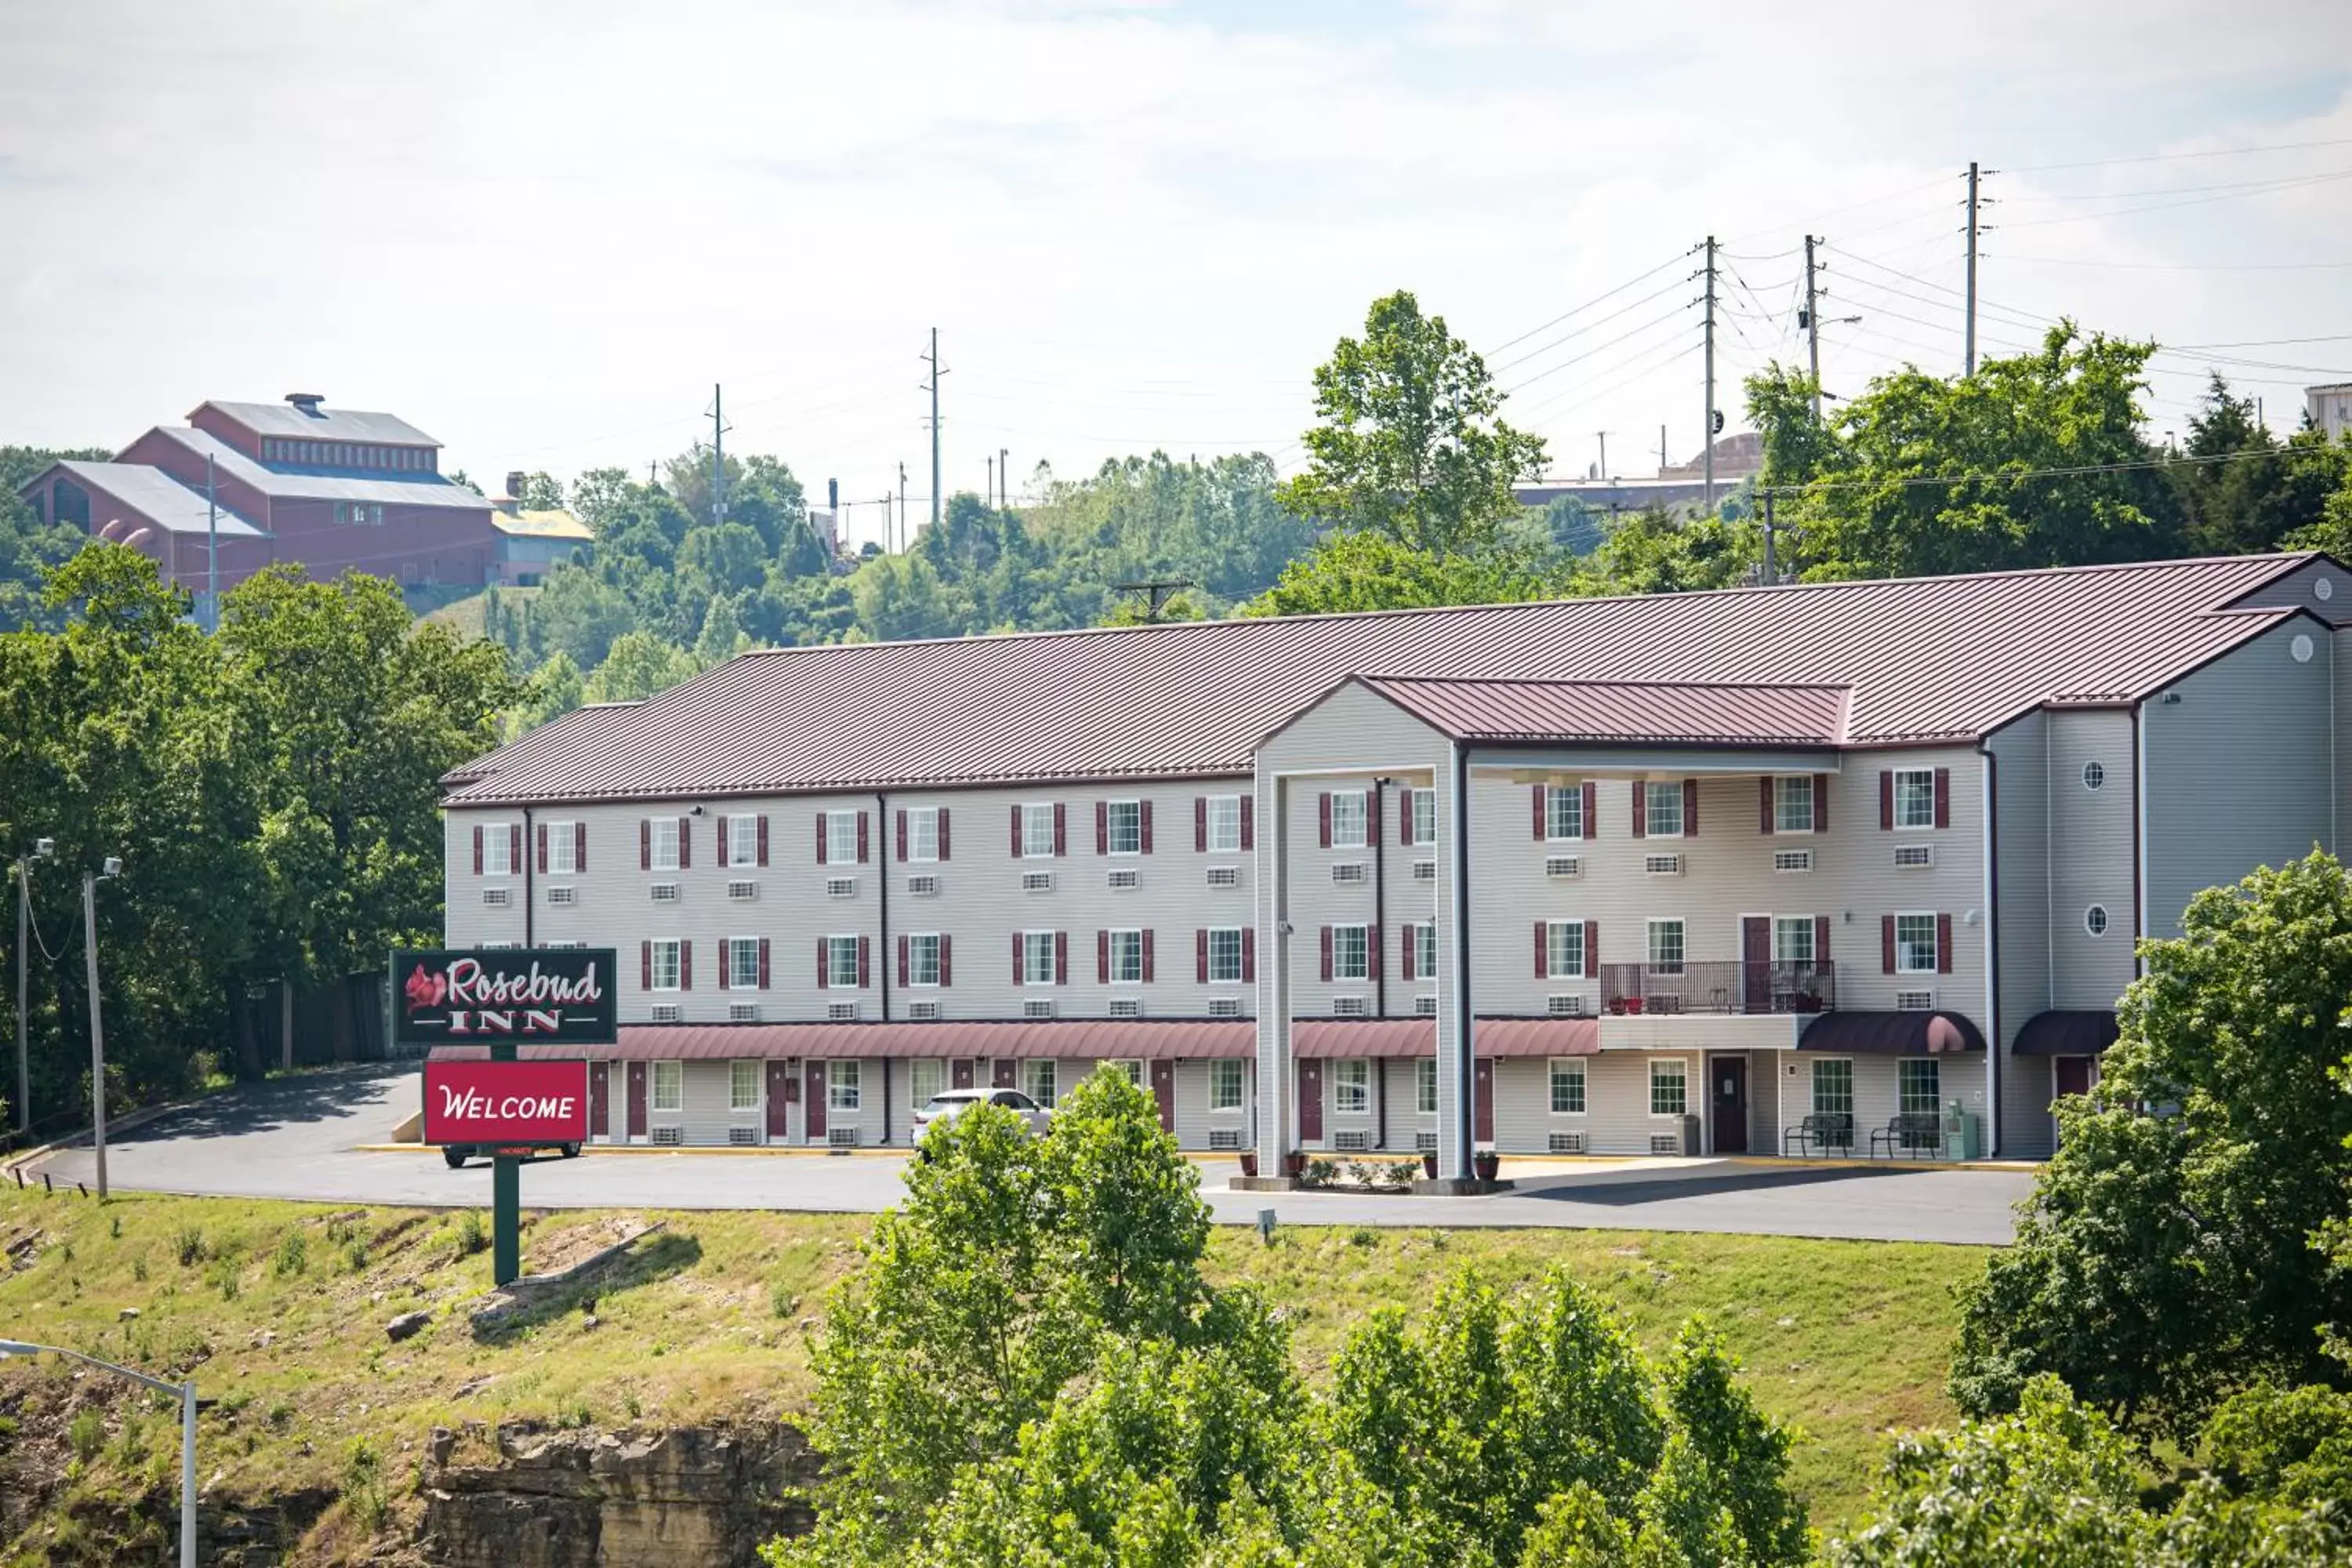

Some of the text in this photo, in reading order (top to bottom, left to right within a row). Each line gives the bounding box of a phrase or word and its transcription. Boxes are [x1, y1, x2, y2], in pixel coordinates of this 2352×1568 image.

[446, 957, 602, 1005] Rosebud
[448, 1009, 563, 1033] INN
[438, 1084, 576, 1120] WELCOME
